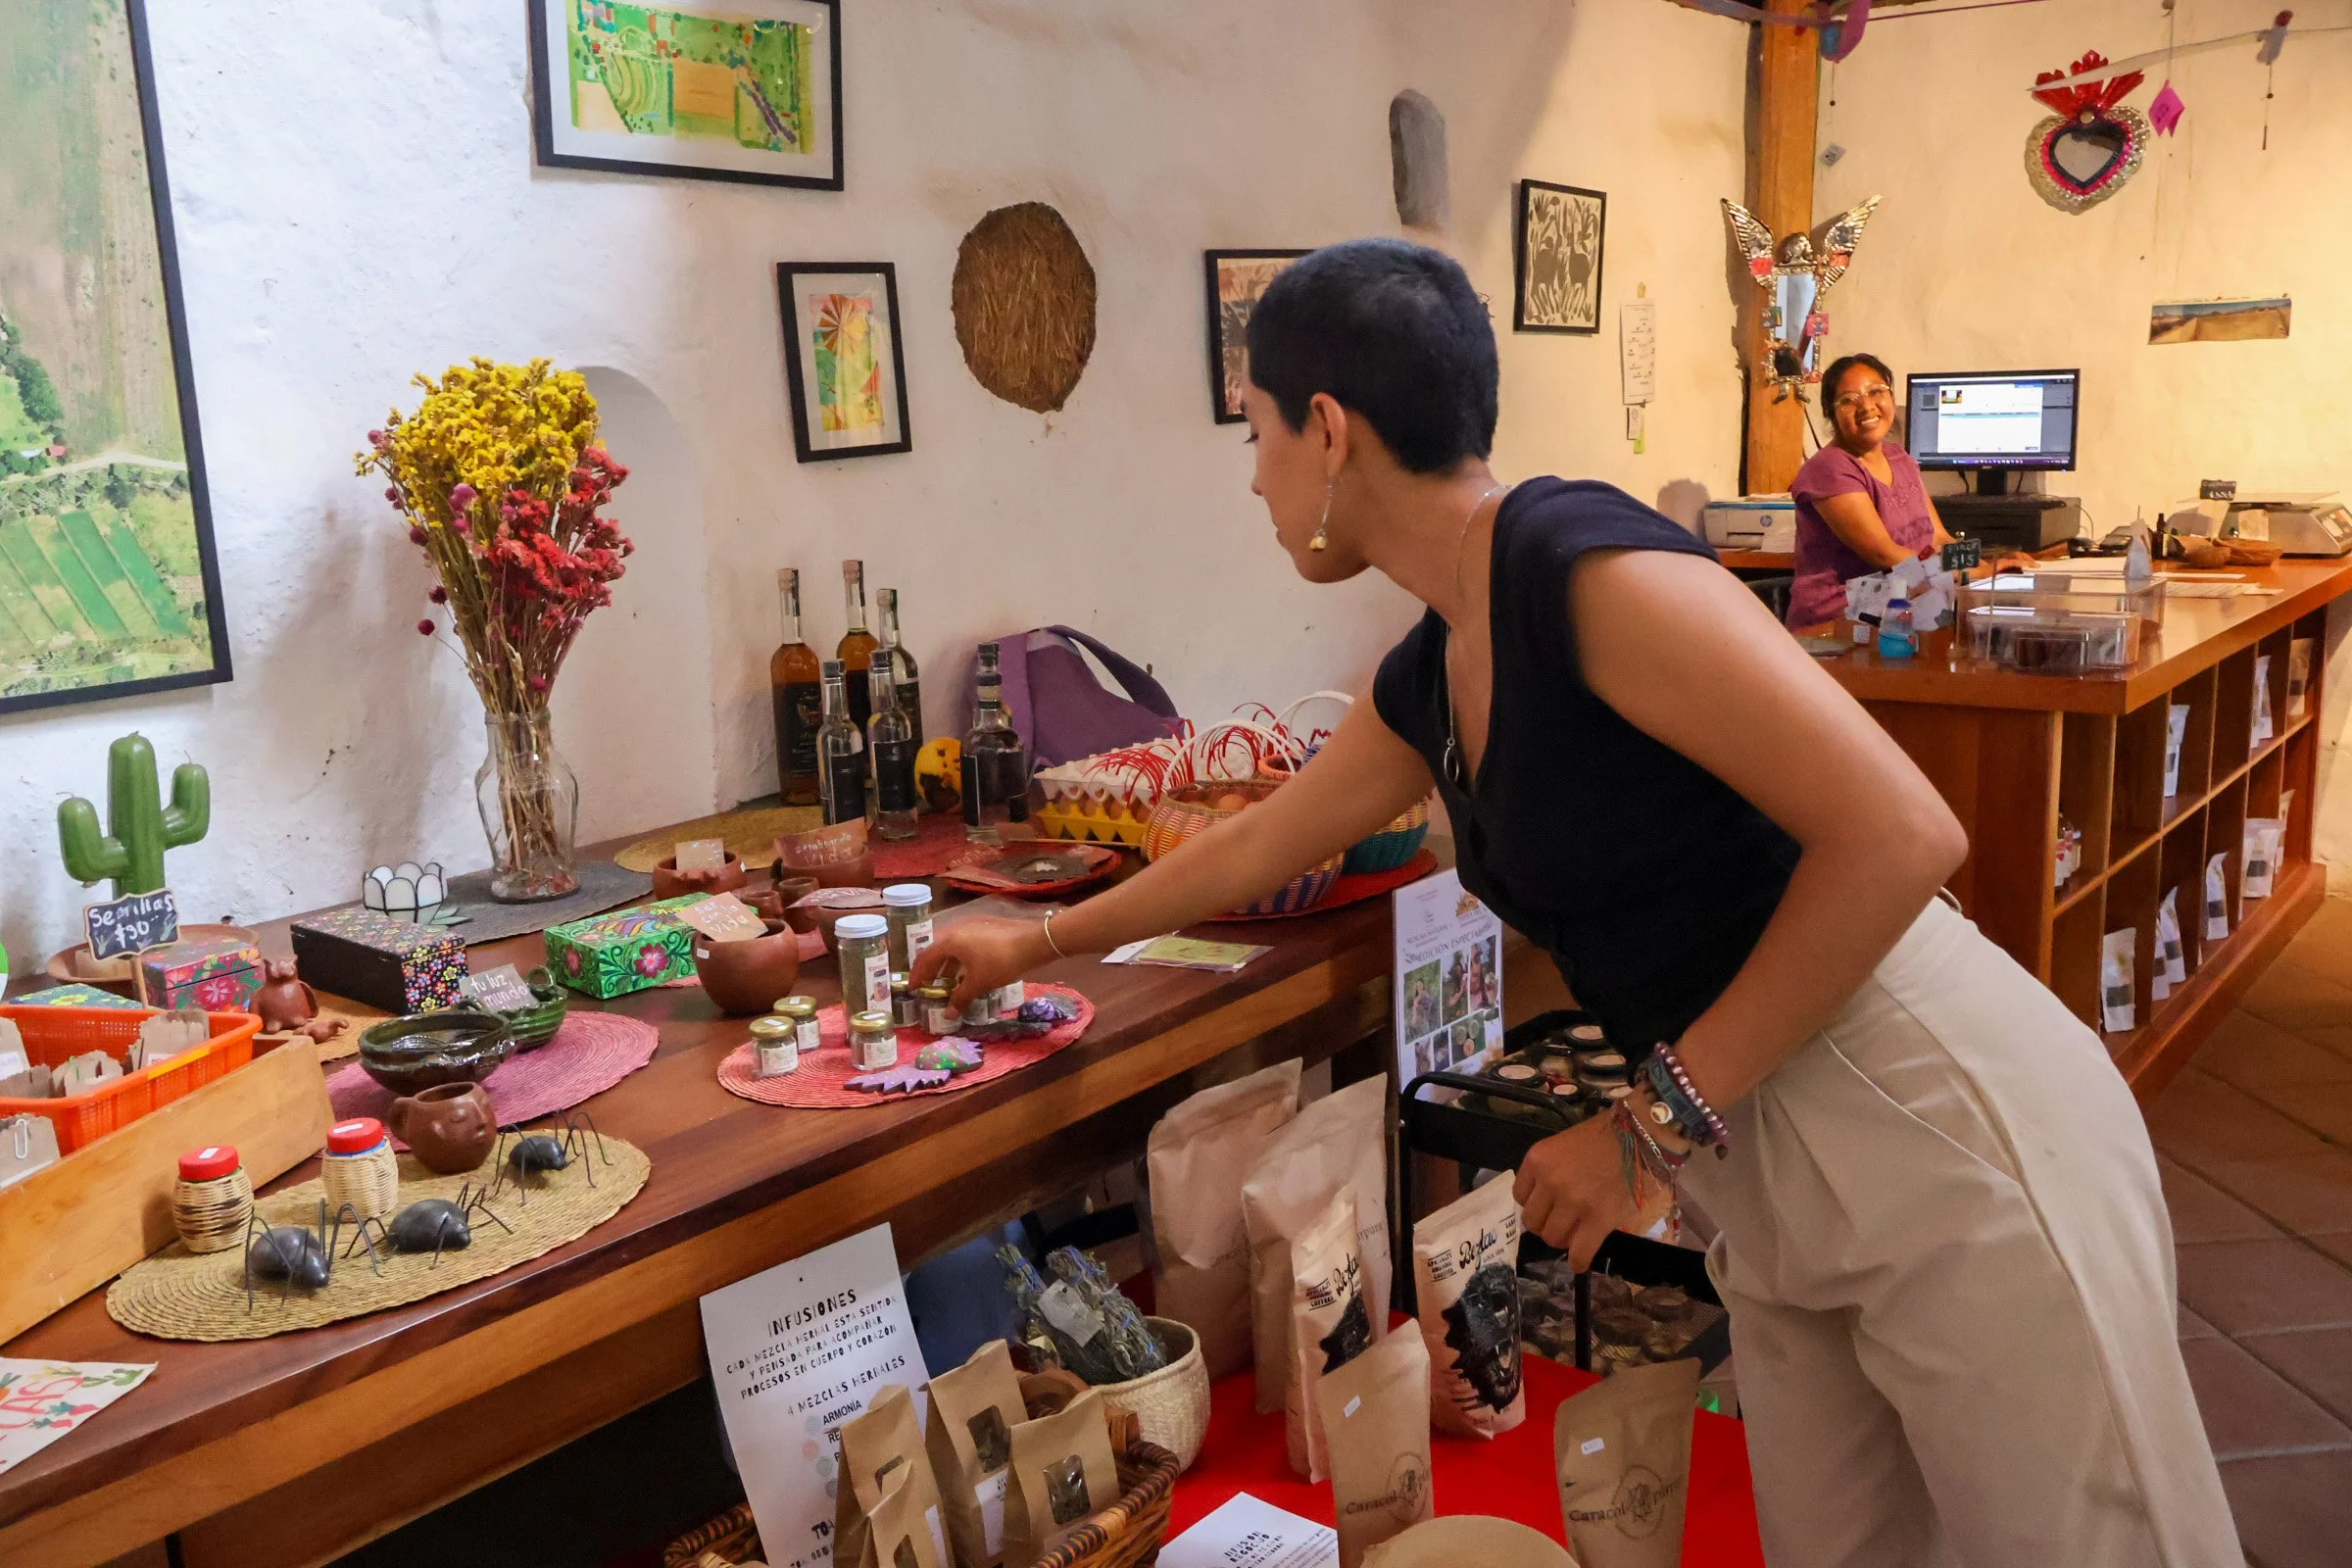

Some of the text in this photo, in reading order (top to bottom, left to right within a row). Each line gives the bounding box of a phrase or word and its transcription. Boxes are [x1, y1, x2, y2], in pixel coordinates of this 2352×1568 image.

[470, 973, 508, 994] tu luz
[727, 1357, 751, 1374] CADA
[755, 1341, 792, 1362] MEZCLA
[796, 1324, 831, 1344] HERBAL
[859, 1296, 897, 1318] SENTIDA
[767, 1289, 858, 1338] INFUSIONES
[741, 1370, 791, 1399] PROCESOS
[794, 1363, 808, 1377] EN
[810, 1347, 844, 1369] CUERPO
[847, 1343, 853, 1352] Y
[750, 1370, 756, 1380] Y
[760, 1350, 803, 1376] PENSADA
[806, 1340, 828, 1355] PARA
[788, 1355, 906, 1416] 4 MEZCLAS HERBALES
[823, 1398, 862, 1426] ARMONÍA
